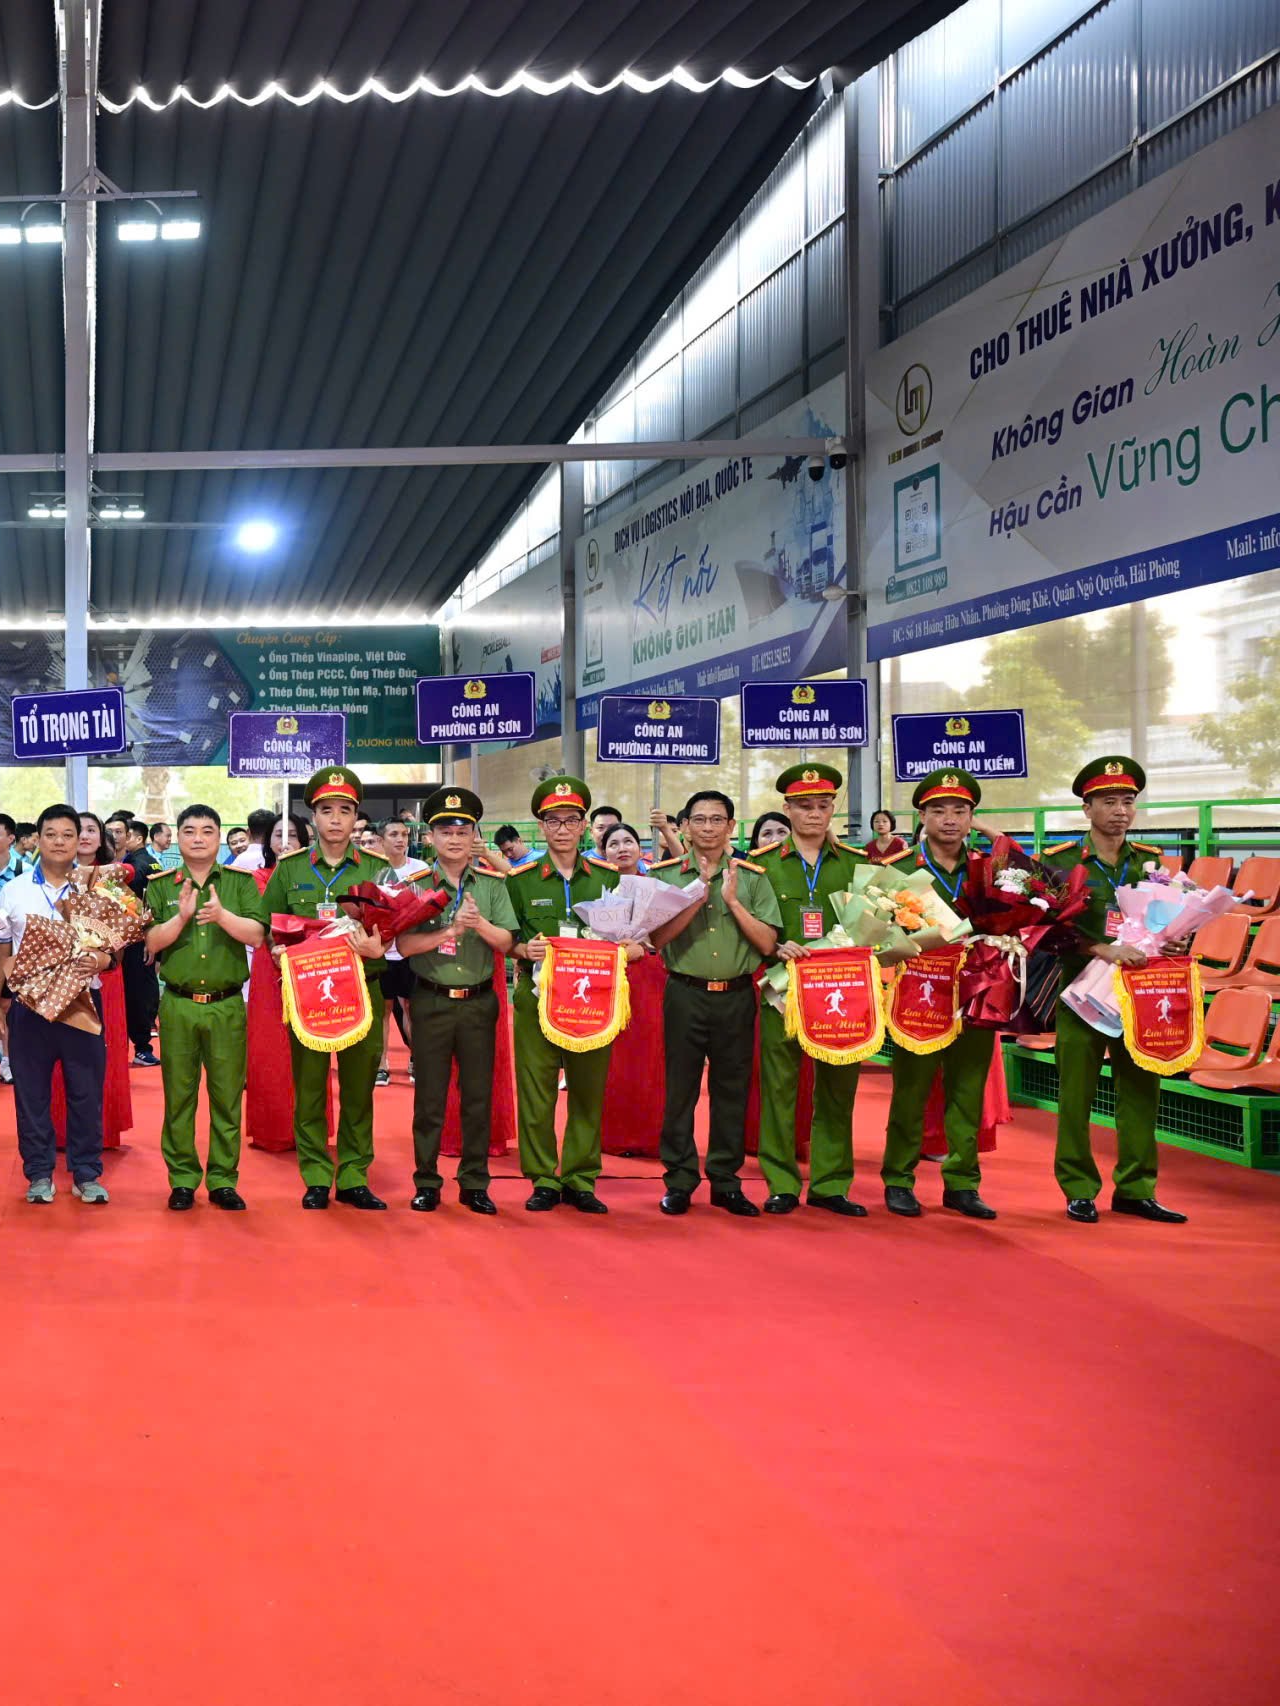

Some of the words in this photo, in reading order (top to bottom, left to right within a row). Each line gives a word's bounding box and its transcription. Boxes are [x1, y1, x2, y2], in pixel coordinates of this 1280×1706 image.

[970, 331, 1010, 380] CHO
[1016, 289, 1072, 356] THUÊ
[1080, 258, 1133, 323] NHÀ
[1141, 202, 1253, 292] XƯỞNG,
[992, 408, 1064, 460] Không
[1072, 378, 1134, 425] Gian
[1144, 322, 1243, 396] Hoàn
[1037, 475, 1082, 520] Cần
[1087, 425, 1200, 500] Vững
[614, 530, 629, 556] DỊCH
[630, 519, 640, 548] VỤ
[641, 497, 678, 540] LOGISTICS
[680, 484, 694, 520] NỘI
[695, 478, 713, 512] ĐỊA,
[1052, 582, 1075, 606] Quận
[1076, 576, 1094, 600] Ngô
[1129, 563, 1147, 584] Hải
[1149, 557, 1180, 579] Phòng
[1226, 534, 1256, 560] Mail:
[633, 545, 686, 638] Kết
[682, 544, 719, 604] nối
[633, 629, 673, 665] KHÔNG
[707, 604, 736, 643] HẠN
[268, 650, 288, 664] Ống
[291, 651, 314, 664] Thép
[317, 651, 363, 664] Vinapipe,
[365, 650, 385, 665] Việt
[387, 650, 406, 661] Đức
[268, 667, 288, 681] Ống
[291, 669, 315, 682] Thép
[317, 669, 347, 681] PCCC,
[350, 666, 369, 680] Ống
[372, 668, 396, 681] Thép
[269, 686, 293, 699] Thép
[295, 684, 318, 698] Ống,
[320, 687, 341, 699] Hộp
[342, 686, 360, 696] Tôn
[362, 686, 382, 698] Mạ,
[384, 684, 408, 698] Thép
[342, 702, 369, 715] Nóng
[451, 702, 481, 719] CÔNG
[484, 703, 500, 717] AN
[778, 707, 810, 723] CÔNG
[812, 709, 829, 722] AN
[20, 703, 38, 745] TỔ
[41, 710, 90, 748] TRỌNG
[92, 703, 116, 739] TÀI
[431, 720, 477, 738] PHƯỜNG
[497, 719, 521, 734] SƠN
[634, 722, 665, 738] CÔNG
[667, 725, 683, 738] AN
[747, 724, 791, 742] PHƯỜNG
[794, 727, 820, 741] NAM
[839, 725, 862, 741] SƠN
[263, 737, 293, 753] CÔNG
[295, 740, 311, 753] AN
[394, 738, 417, 747] KINH
[608, 739, 652, 756] PHƯỜNG
[653, 743, 669, 756] AN
[671, 744, 708, 757] PHONG
[933, 739, 966, 755] CÔNG
[968, 740, 985, 753] AN
[239, 755, 281, 771] PHƯỜNG
[283, 758, 312, 771] HƯNG
[906, 757, 955, 775] PHƯỜNG
[958, 758, 980, 772] LƯU
[984, 754, 1015, 771] KIẾM
